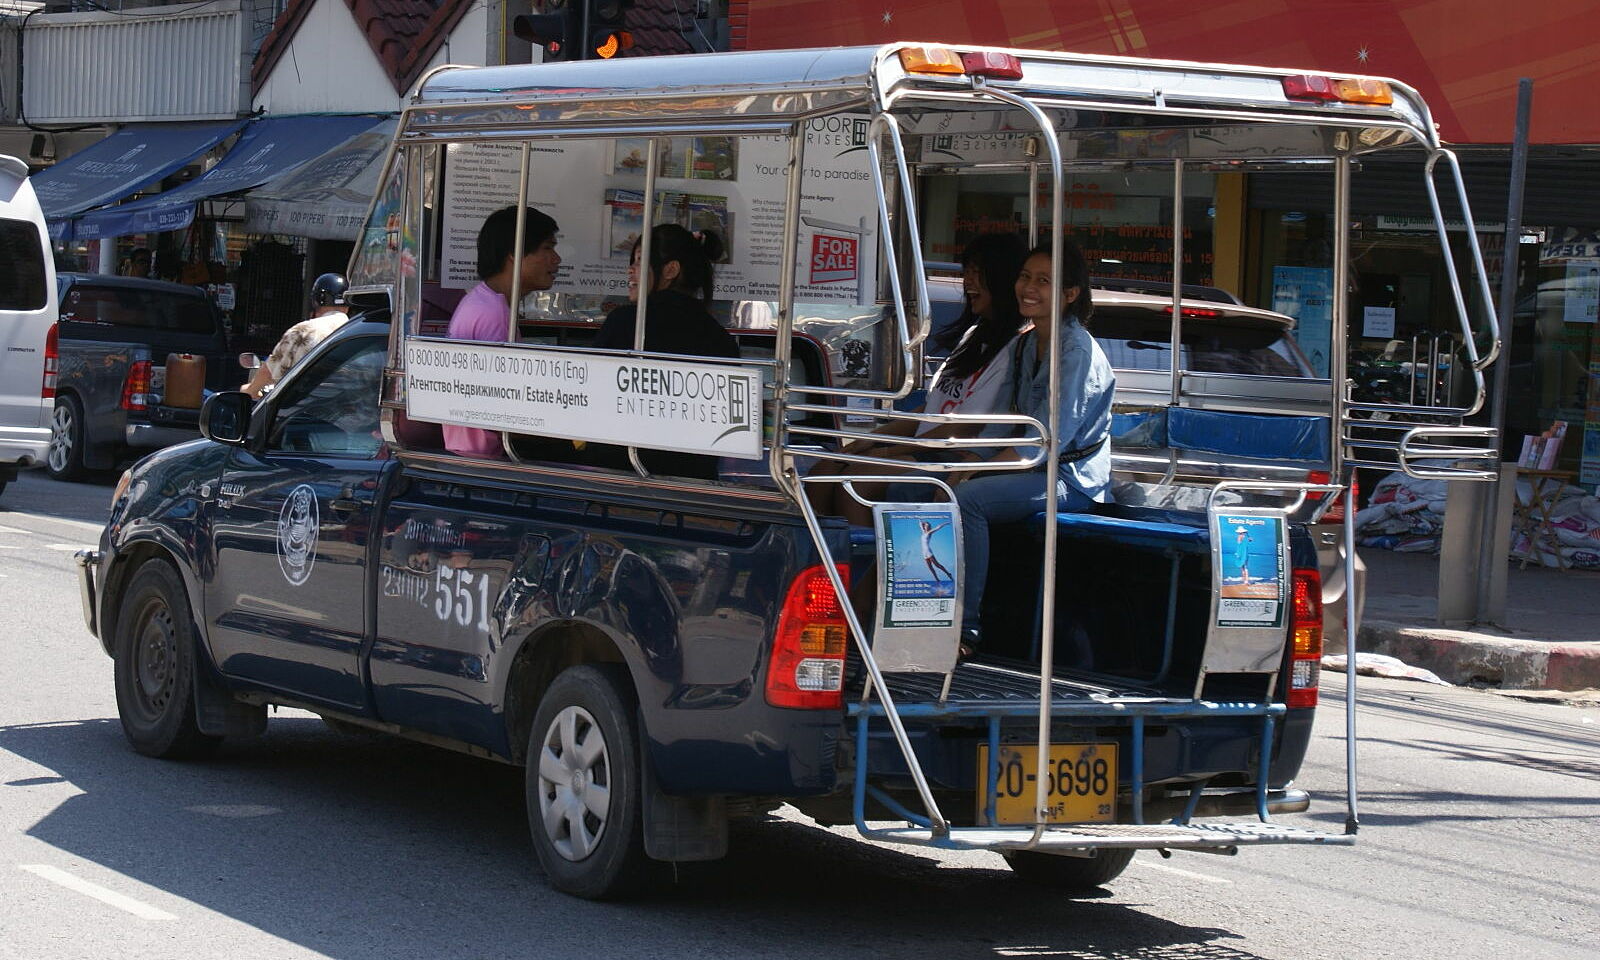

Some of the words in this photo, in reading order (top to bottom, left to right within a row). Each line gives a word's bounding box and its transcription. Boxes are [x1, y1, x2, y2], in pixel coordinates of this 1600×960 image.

[755, 164, 779, 175] Your
[810, 166, 821, 177] to
[824, 167, 870, 181] paradise
[290, 211, 301, 223] 100
[301, 212, 326, 225] PIPERS
[818, 237, 852, 255] FOR
[814, 253, 854, 270] SALE
[408, 349, 415, 363] 0
[416, 349, 432, 365] 800
[434, 350, 450, 367] 800
[452, 352, 468, 369] 498
[469, 352, 488, 373] (Ru)
[494, 354, 507, 372] 08
[508, 355, 520, 373] 70
[521, 356, 533, 374] 70
[534, 357, 547, 376] 70
[549, 358, 561, 378] 16
[562, 359, 589, 384] (Eng)
[409, 375, 452, 393] Агентство
[453, 379, 521, 400] Недвижимости
[526, 387, 553, 404] Estate
[555, 390, 588, 409] Agents
[616, 365, 727, 401] GREENDOOR
[617, 397, 728, 425] ENTERPRISES
[435, 564, 490, 633] 551
